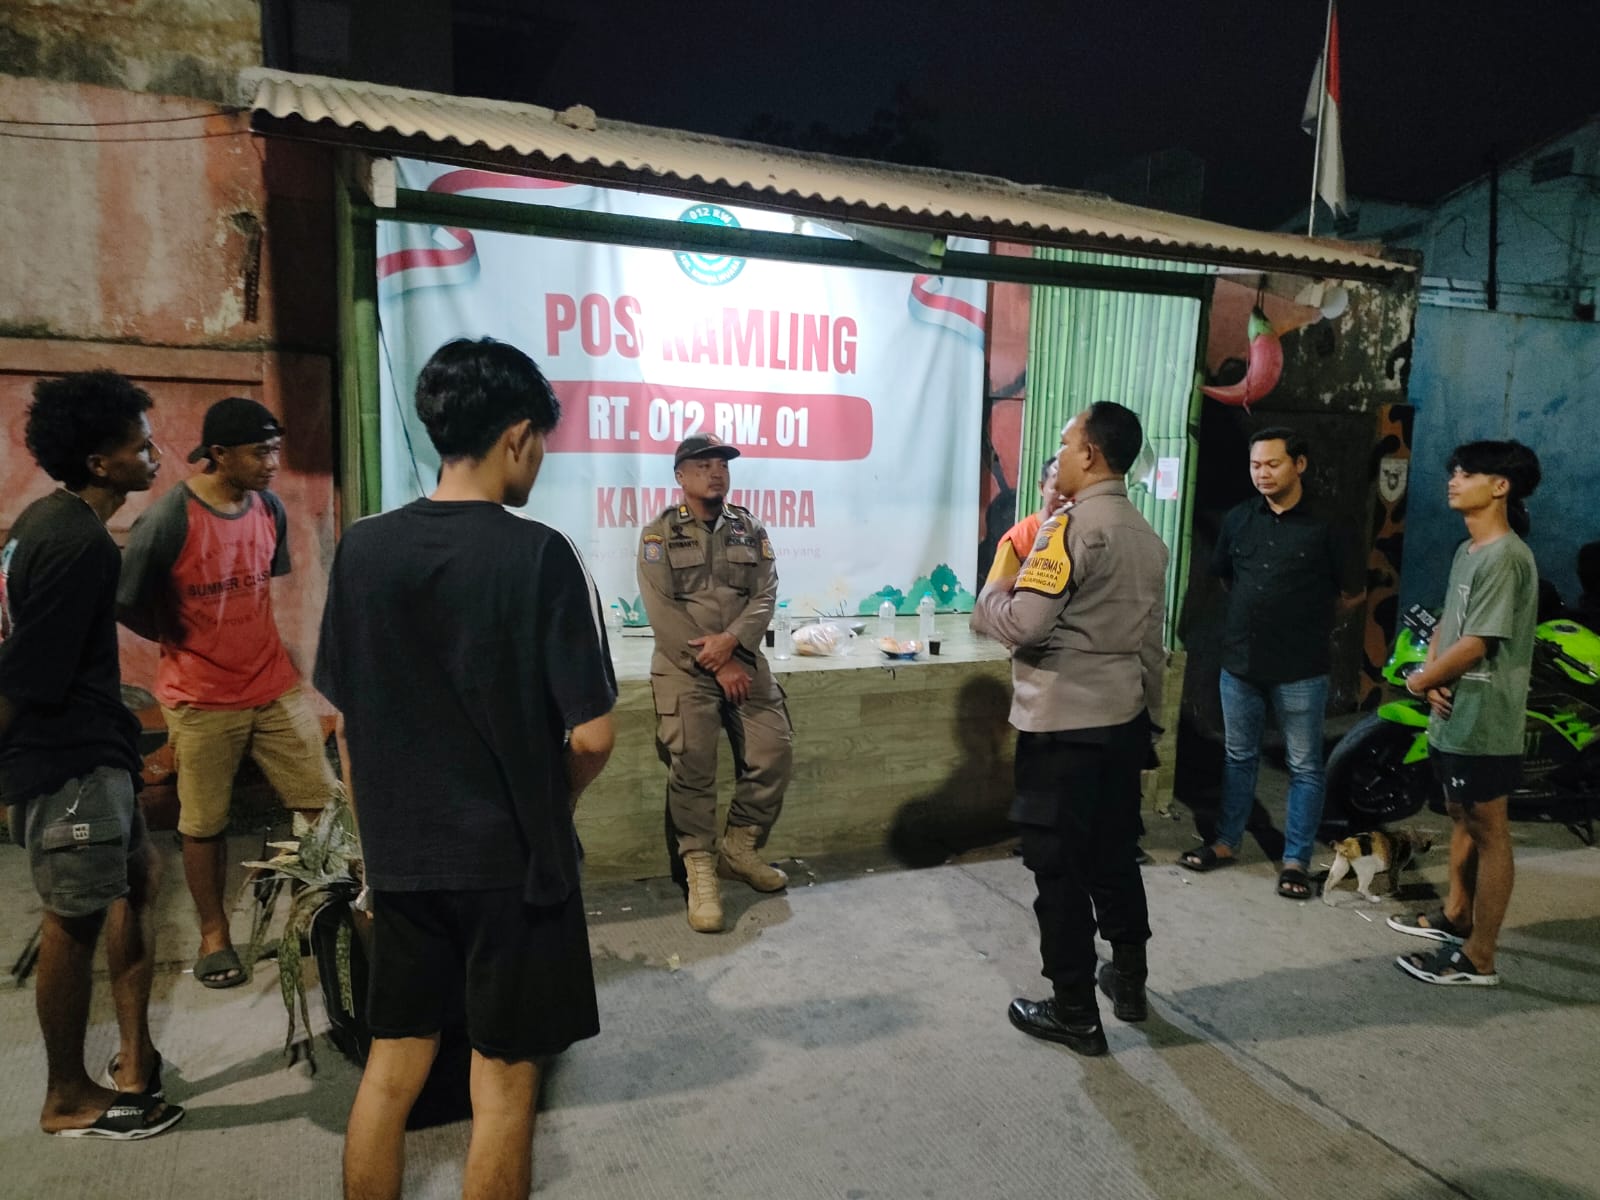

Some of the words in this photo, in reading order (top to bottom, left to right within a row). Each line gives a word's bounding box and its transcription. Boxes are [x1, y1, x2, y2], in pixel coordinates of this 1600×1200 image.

[544, 293, 644, 358] POS
[588, 396, 640, 440] RT.
[649, 398, 704, 442] 012
[714, 402, 768, 446] RW.
[775, 406, 809, 447] 01
[189, 577, 238, 596] SUMMER
